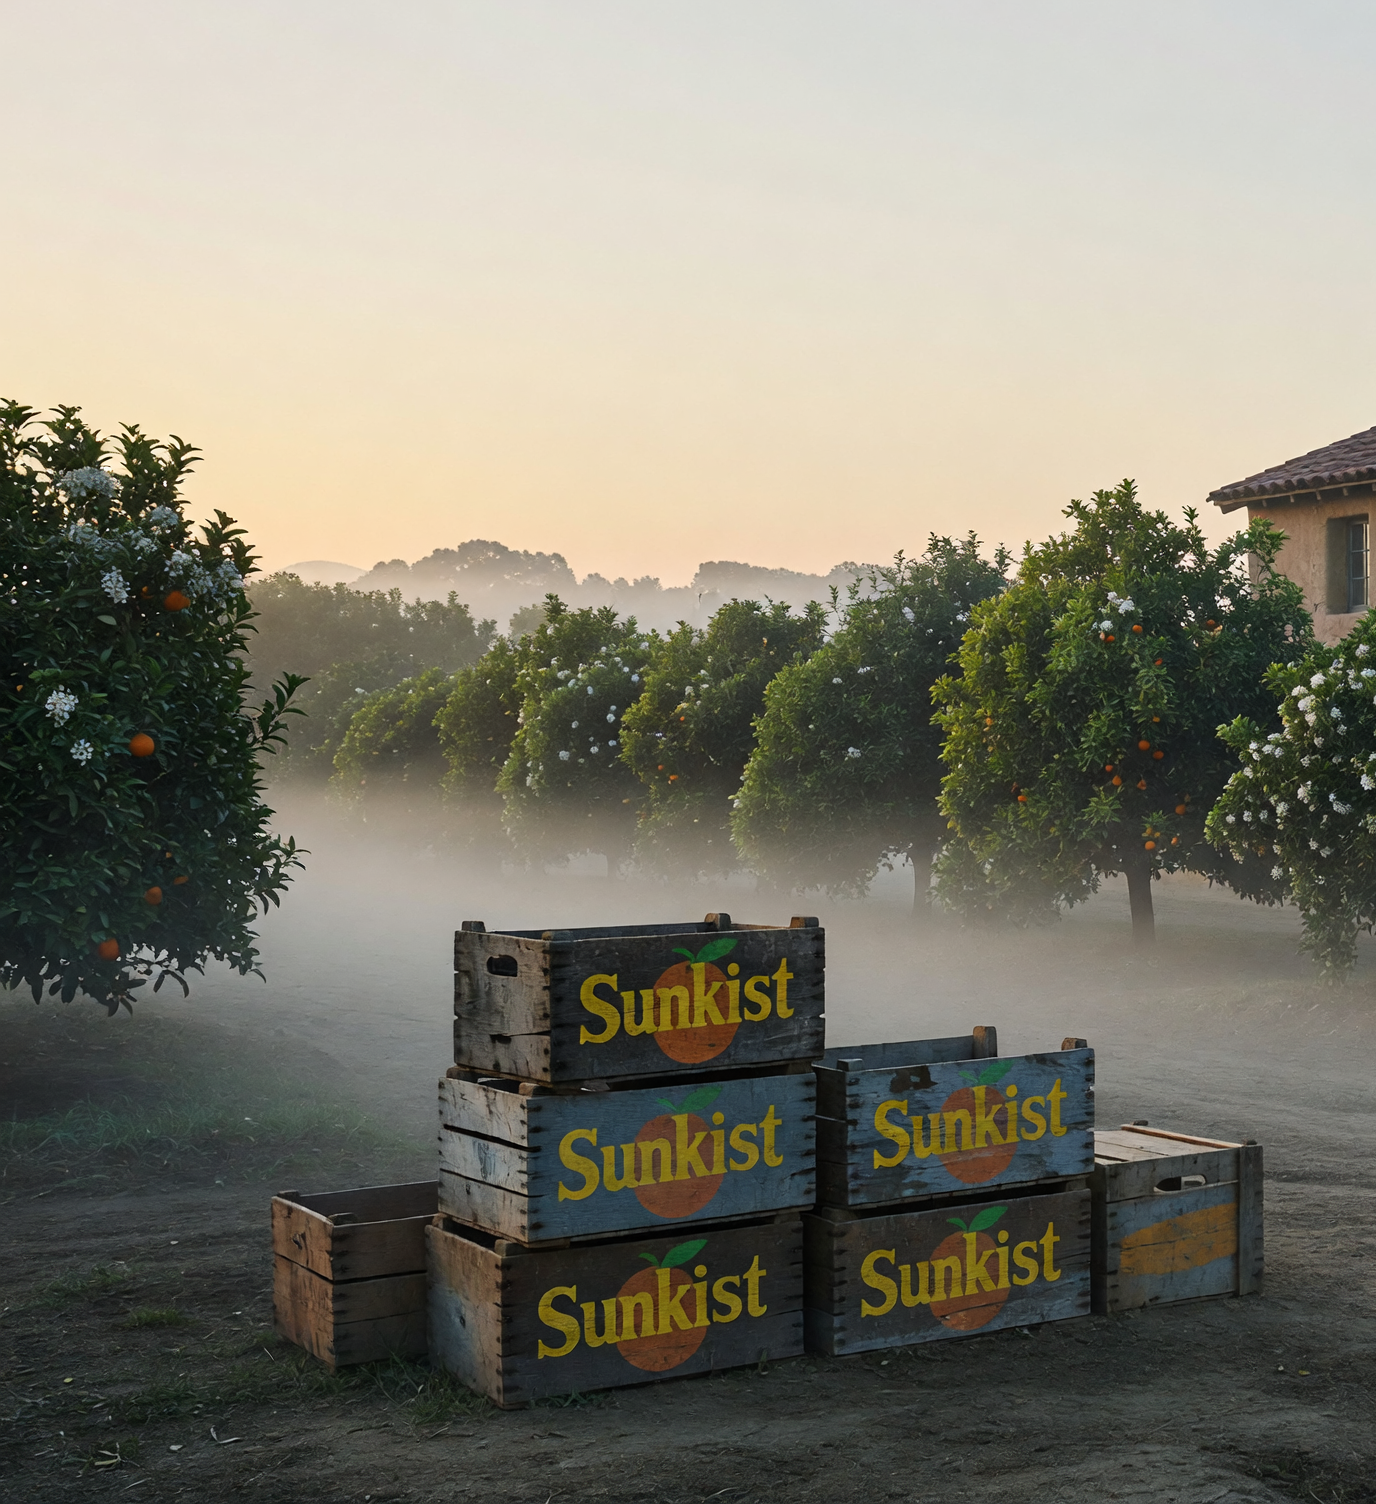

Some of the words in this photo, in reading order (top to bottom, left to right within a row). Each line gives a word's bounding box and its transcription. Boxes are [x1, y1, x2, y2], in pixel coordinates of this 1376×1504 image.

[579, 957, 795, 1045] Sunkist
[558, 1104, 784, 1201] Sunkist
[873, 1078, 1068, 1169] Sunkist
[537, 1255, 767, 1359] Sunkist
[860, 1222, 1062, 1317] Sunkist
